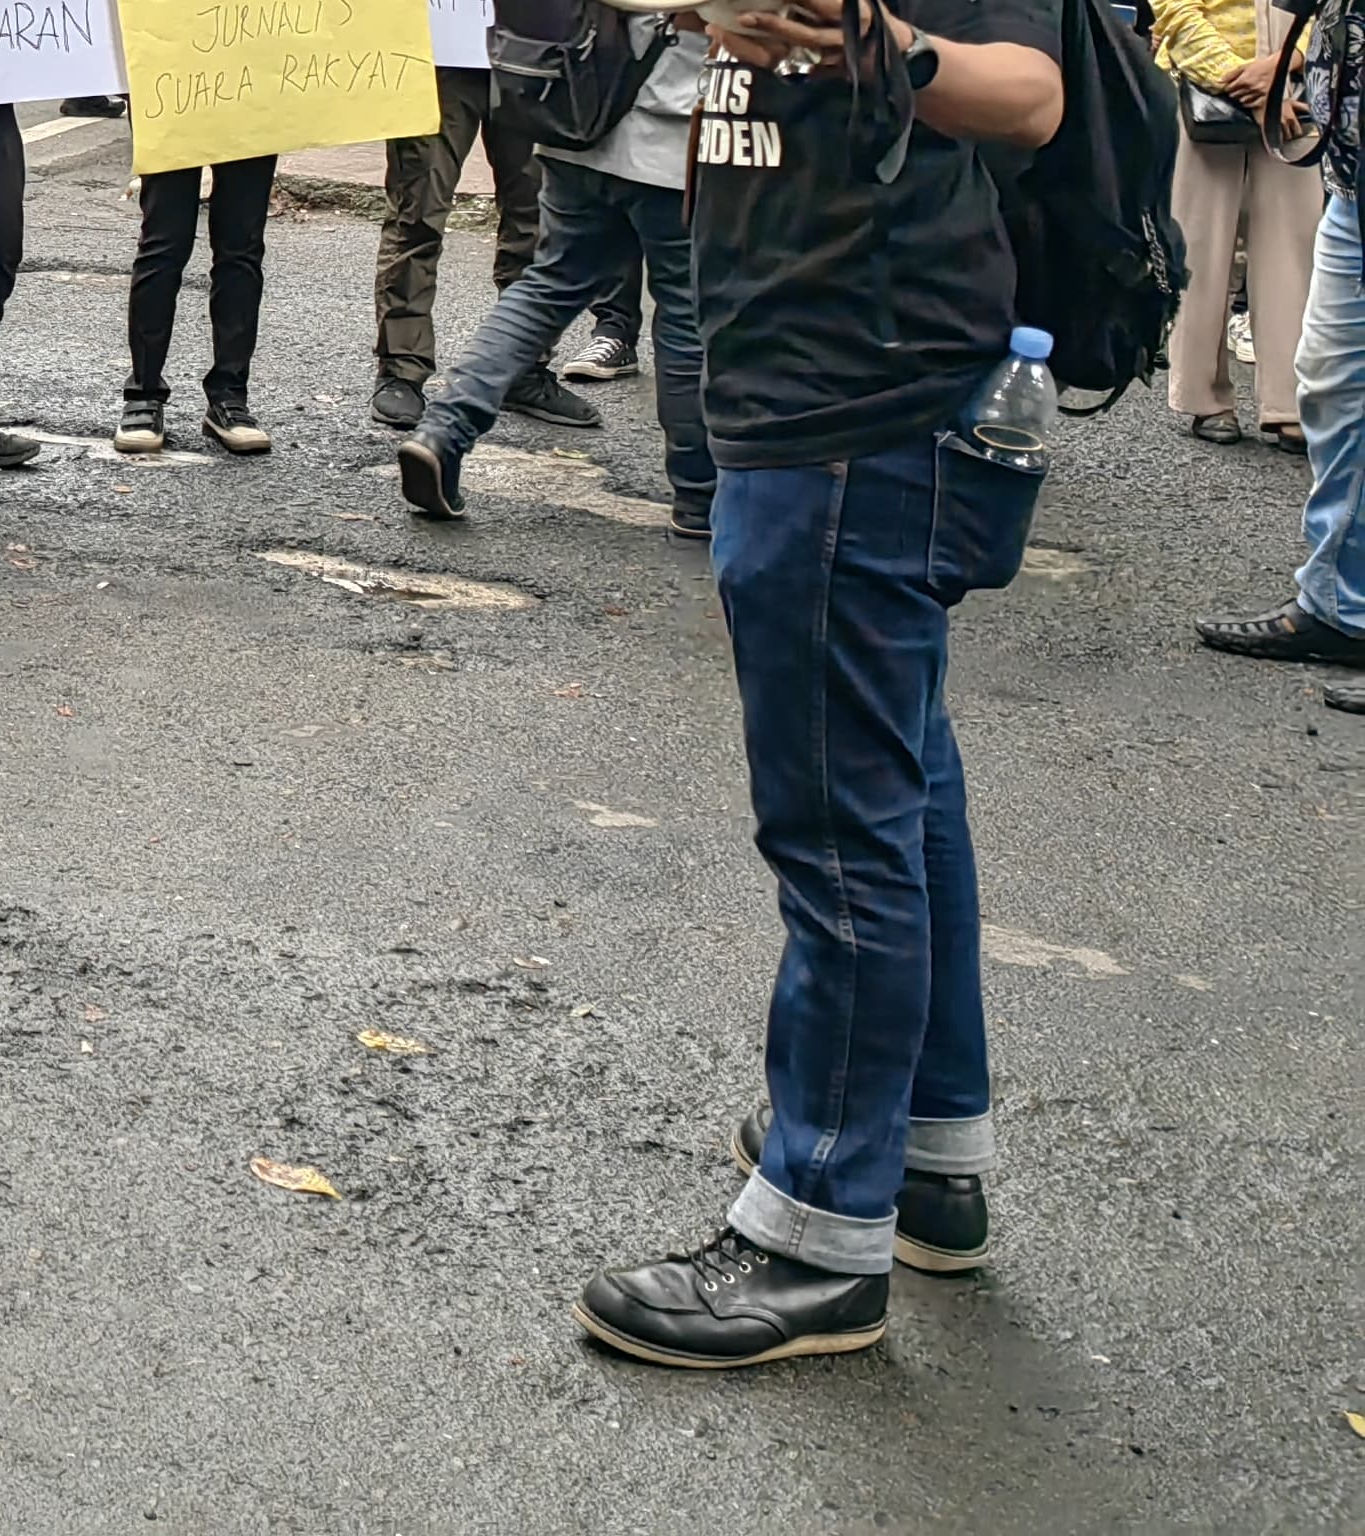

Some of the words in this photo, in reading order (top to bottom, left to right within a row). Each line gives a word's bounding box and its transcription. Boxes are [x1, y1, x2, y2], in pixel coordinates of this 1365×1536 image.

[146, 65, 253, 118] SUARA
[280, 50, 430, 93] RAKYAT
[697, 118, 782, 167] DEN
